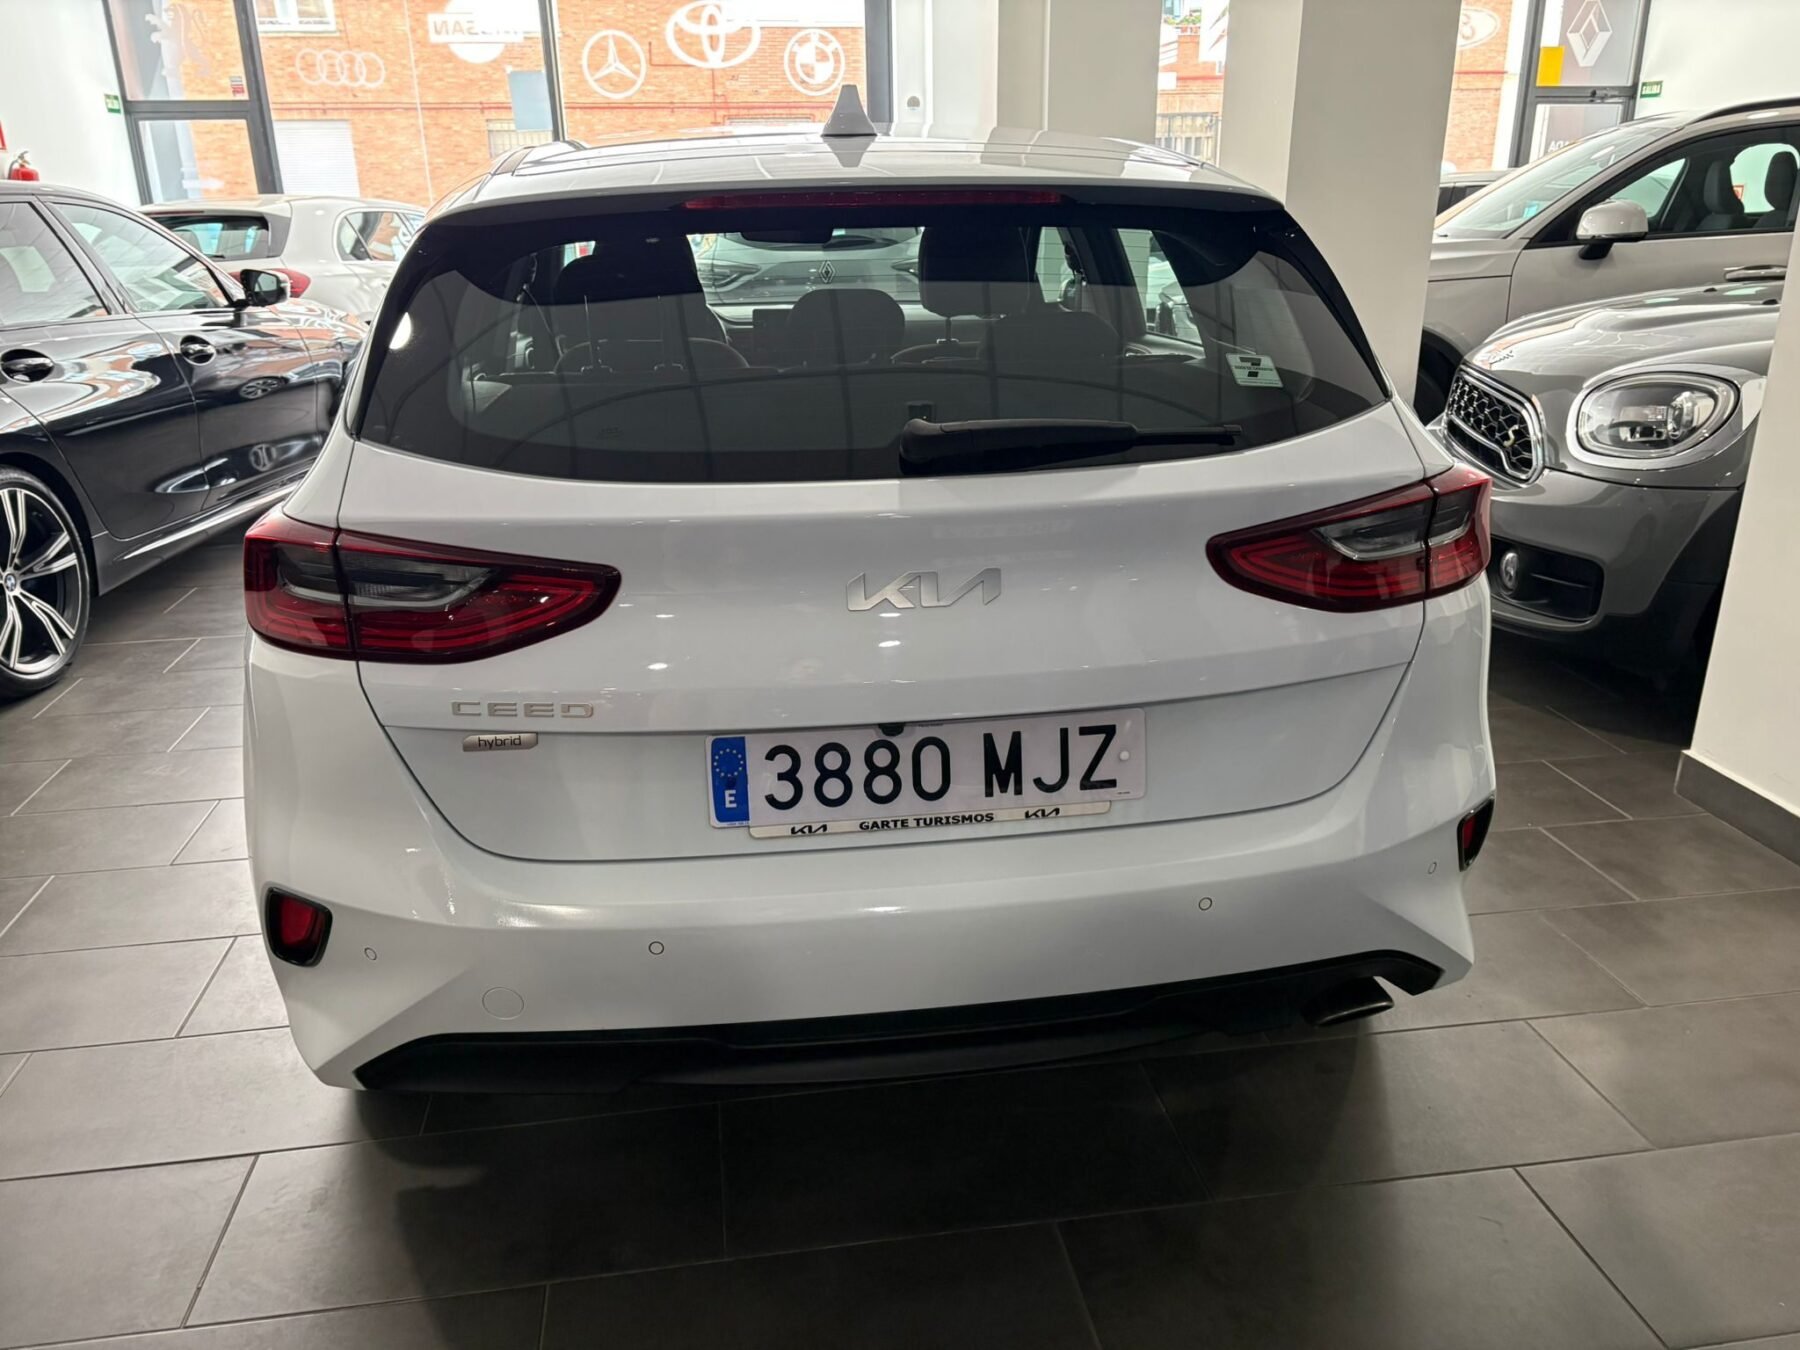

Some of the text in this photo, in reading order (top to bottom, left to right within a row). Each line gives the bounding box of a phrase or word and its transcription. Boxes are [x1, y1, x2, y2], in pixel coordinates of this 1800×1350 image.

[846, 567, 1001, 611] KIA
[452, 702, 594, 718] CEED
[478, 736, 522, 748] hybrid
[764, 724, 1117, 810] 3880 MJZ
[724, 789, 737, 808] E
[790, 807, 1060, 835] KIA GARTE TURISMOS KIA
